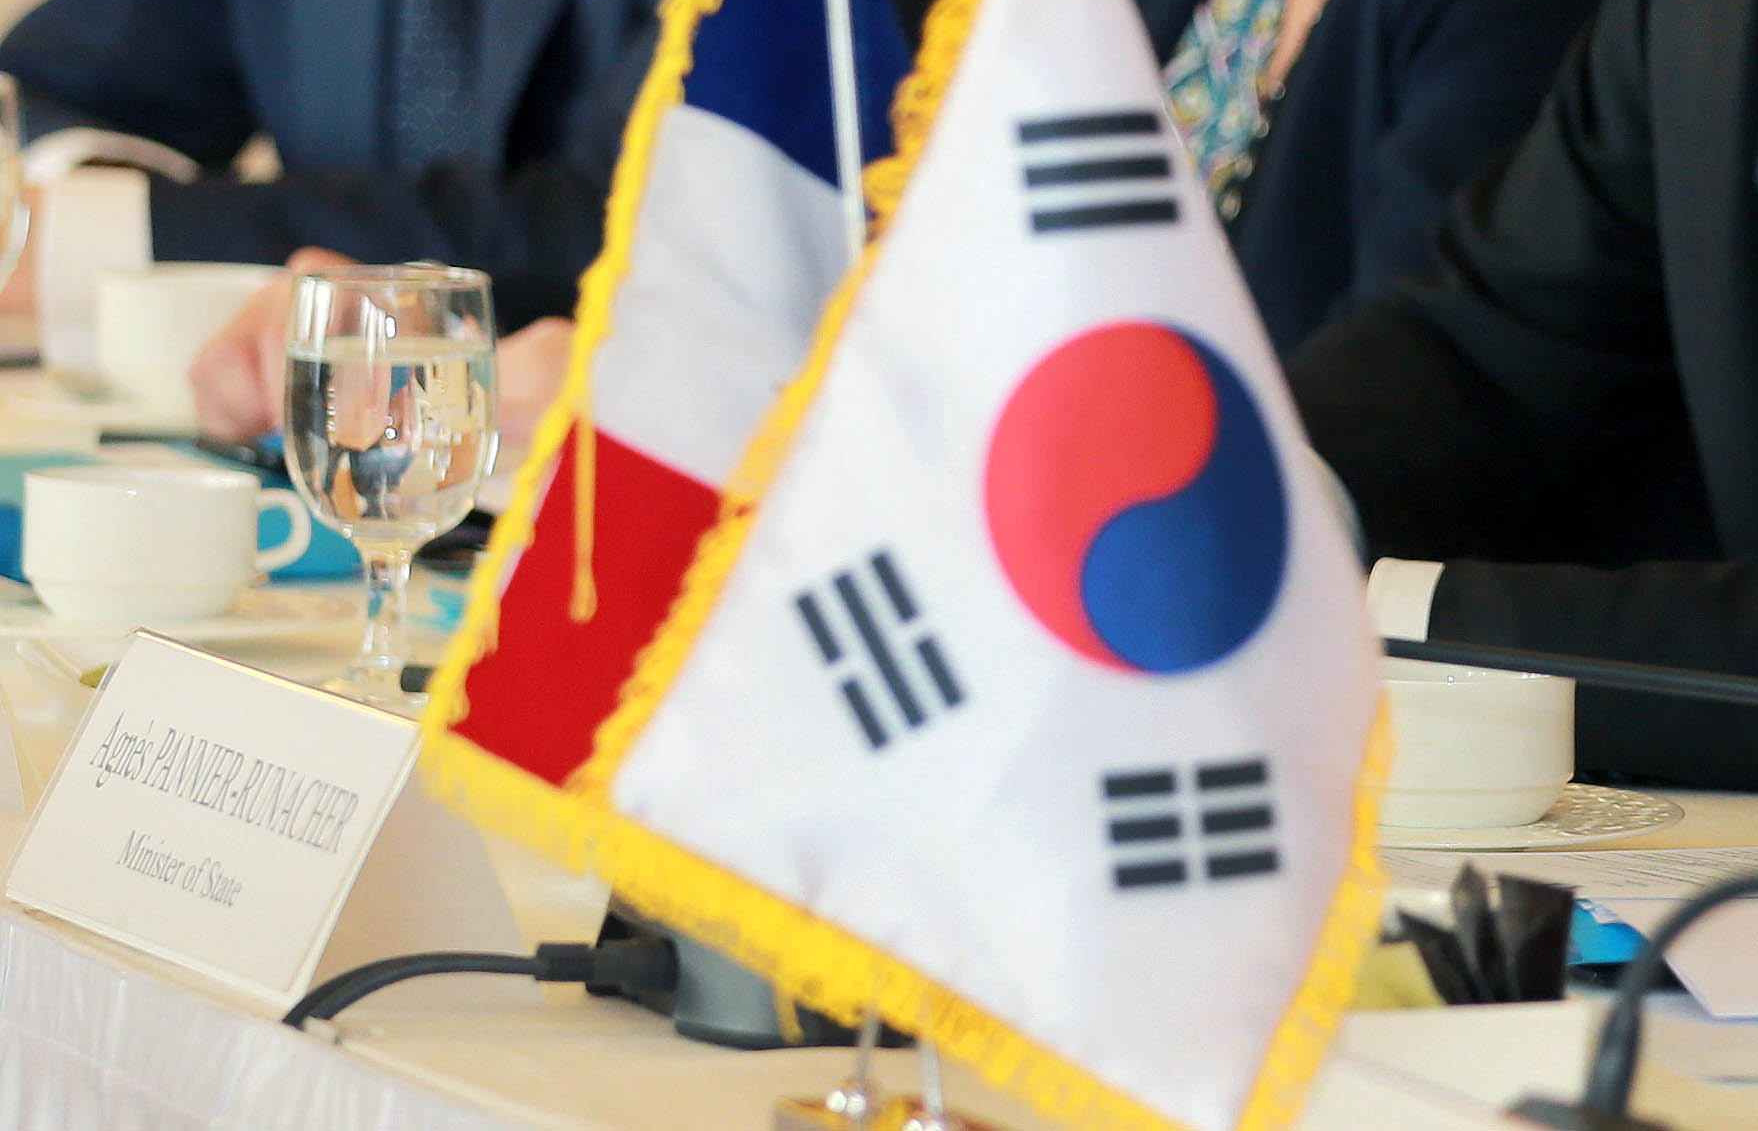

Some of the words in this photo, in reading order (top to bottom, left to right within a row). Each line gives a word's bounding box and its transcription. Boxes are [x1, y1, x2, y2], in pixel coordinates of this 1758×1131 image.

[141, 727, 360, 854] PANNIER-RUNACHER
[115, 829, 186, 886] Minister
[181, 856, 212, 893] of
[199, 860, 243, 908] State
